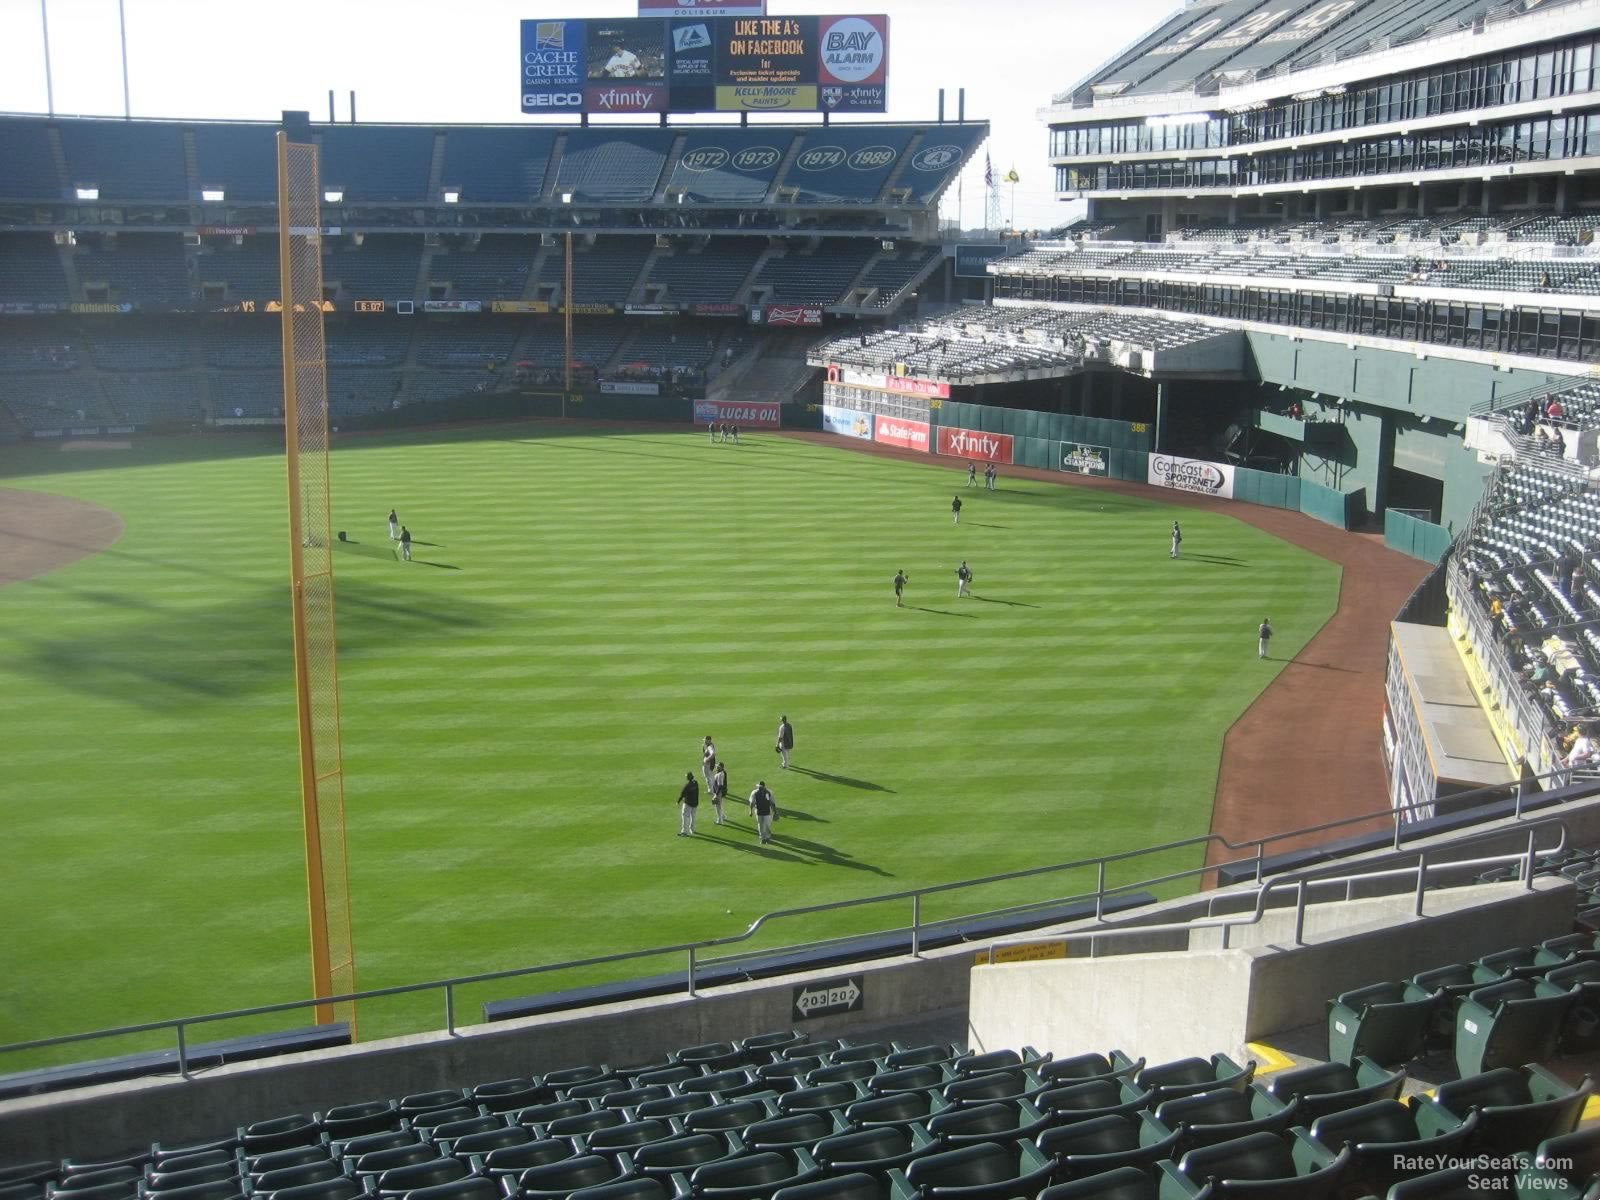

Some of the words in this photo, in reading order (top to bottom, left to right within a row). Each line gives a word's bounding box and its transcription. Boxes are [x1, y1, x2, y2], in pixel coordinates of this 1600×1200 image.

[735, 20, 758, 35] LIKE
[760, 20, 781, 35] THE
[783, 20, 800, 35] A's
[730, 40, 746, 55] ON
[748, 40, 803, 55] FACEBOOK
[826, 32, 876, 51] BAY
[525, 51, 578, 63] CACHE
[825, 53, 874, 64] ALARM
[526, 65, 578, 77] CREEK
[735, 87, 799, 96] KELLY-MOORE
[850, 88, 882, 98] xfinity
[523, 93, 582, 106] GEICO
[600, 89, 653, 109] xfinity
[688, 152, 725, 166] 1972
[738, 152, 775, 165] 1973
[803, 152, 841, 165] 1974
[855, 152, 892, 164] 1989
[720, 407, 757, 420] LUCAS
[759, 408, 777, 421] OIL
[950, 434, 999, 458] xfinity
[1154, 458, 1203, 477] comcast
[1165, 473, 1215, 488] SPORTSNET
[801, 994, 827, 1008] 203
[831, 989, 855, 1003] 202
